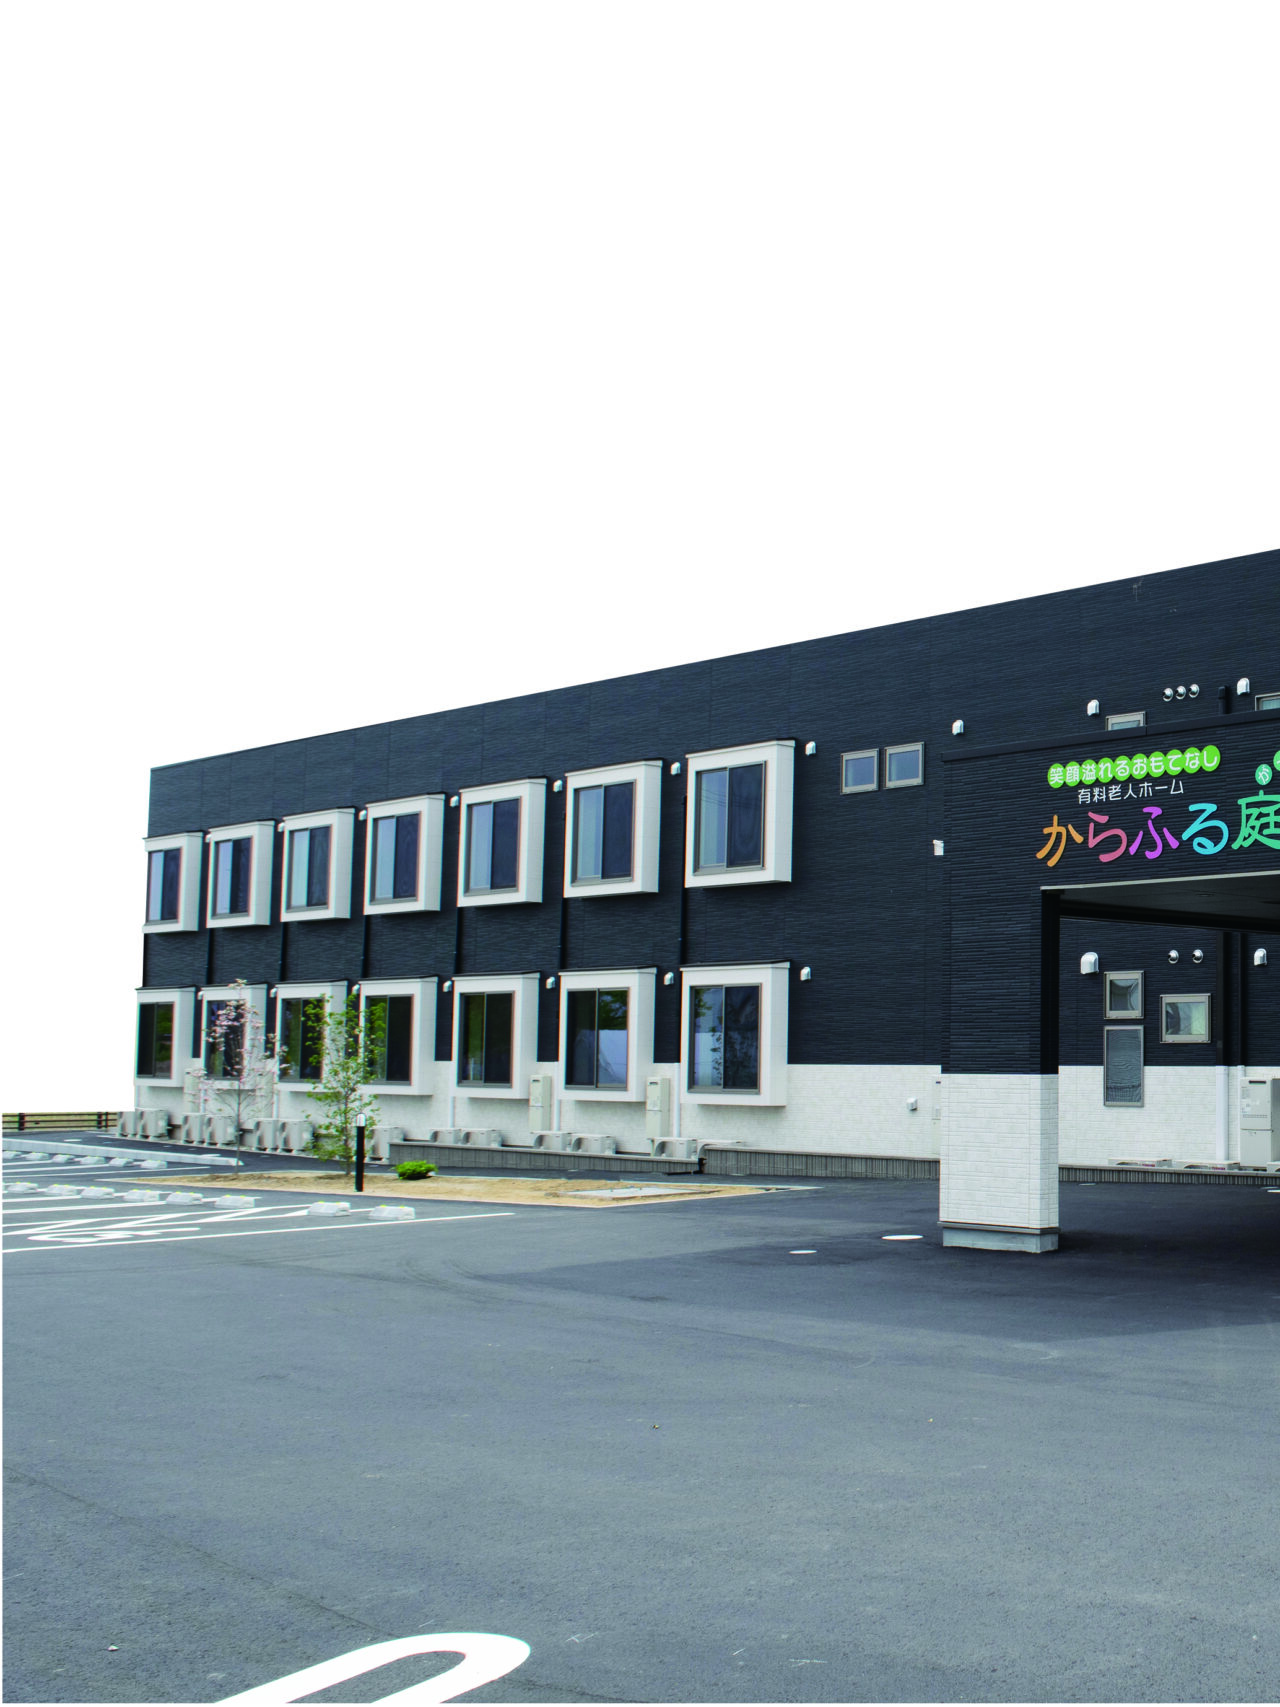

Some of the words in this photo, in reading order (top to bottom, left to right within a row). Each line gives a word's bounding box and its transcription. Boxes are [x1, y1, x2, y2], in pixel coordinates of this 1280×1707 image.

[1049, 749, 1219, 785] 笑顔溢れるおもてなし
[1077, 779, 1184, 805] 有料老人ホーム
